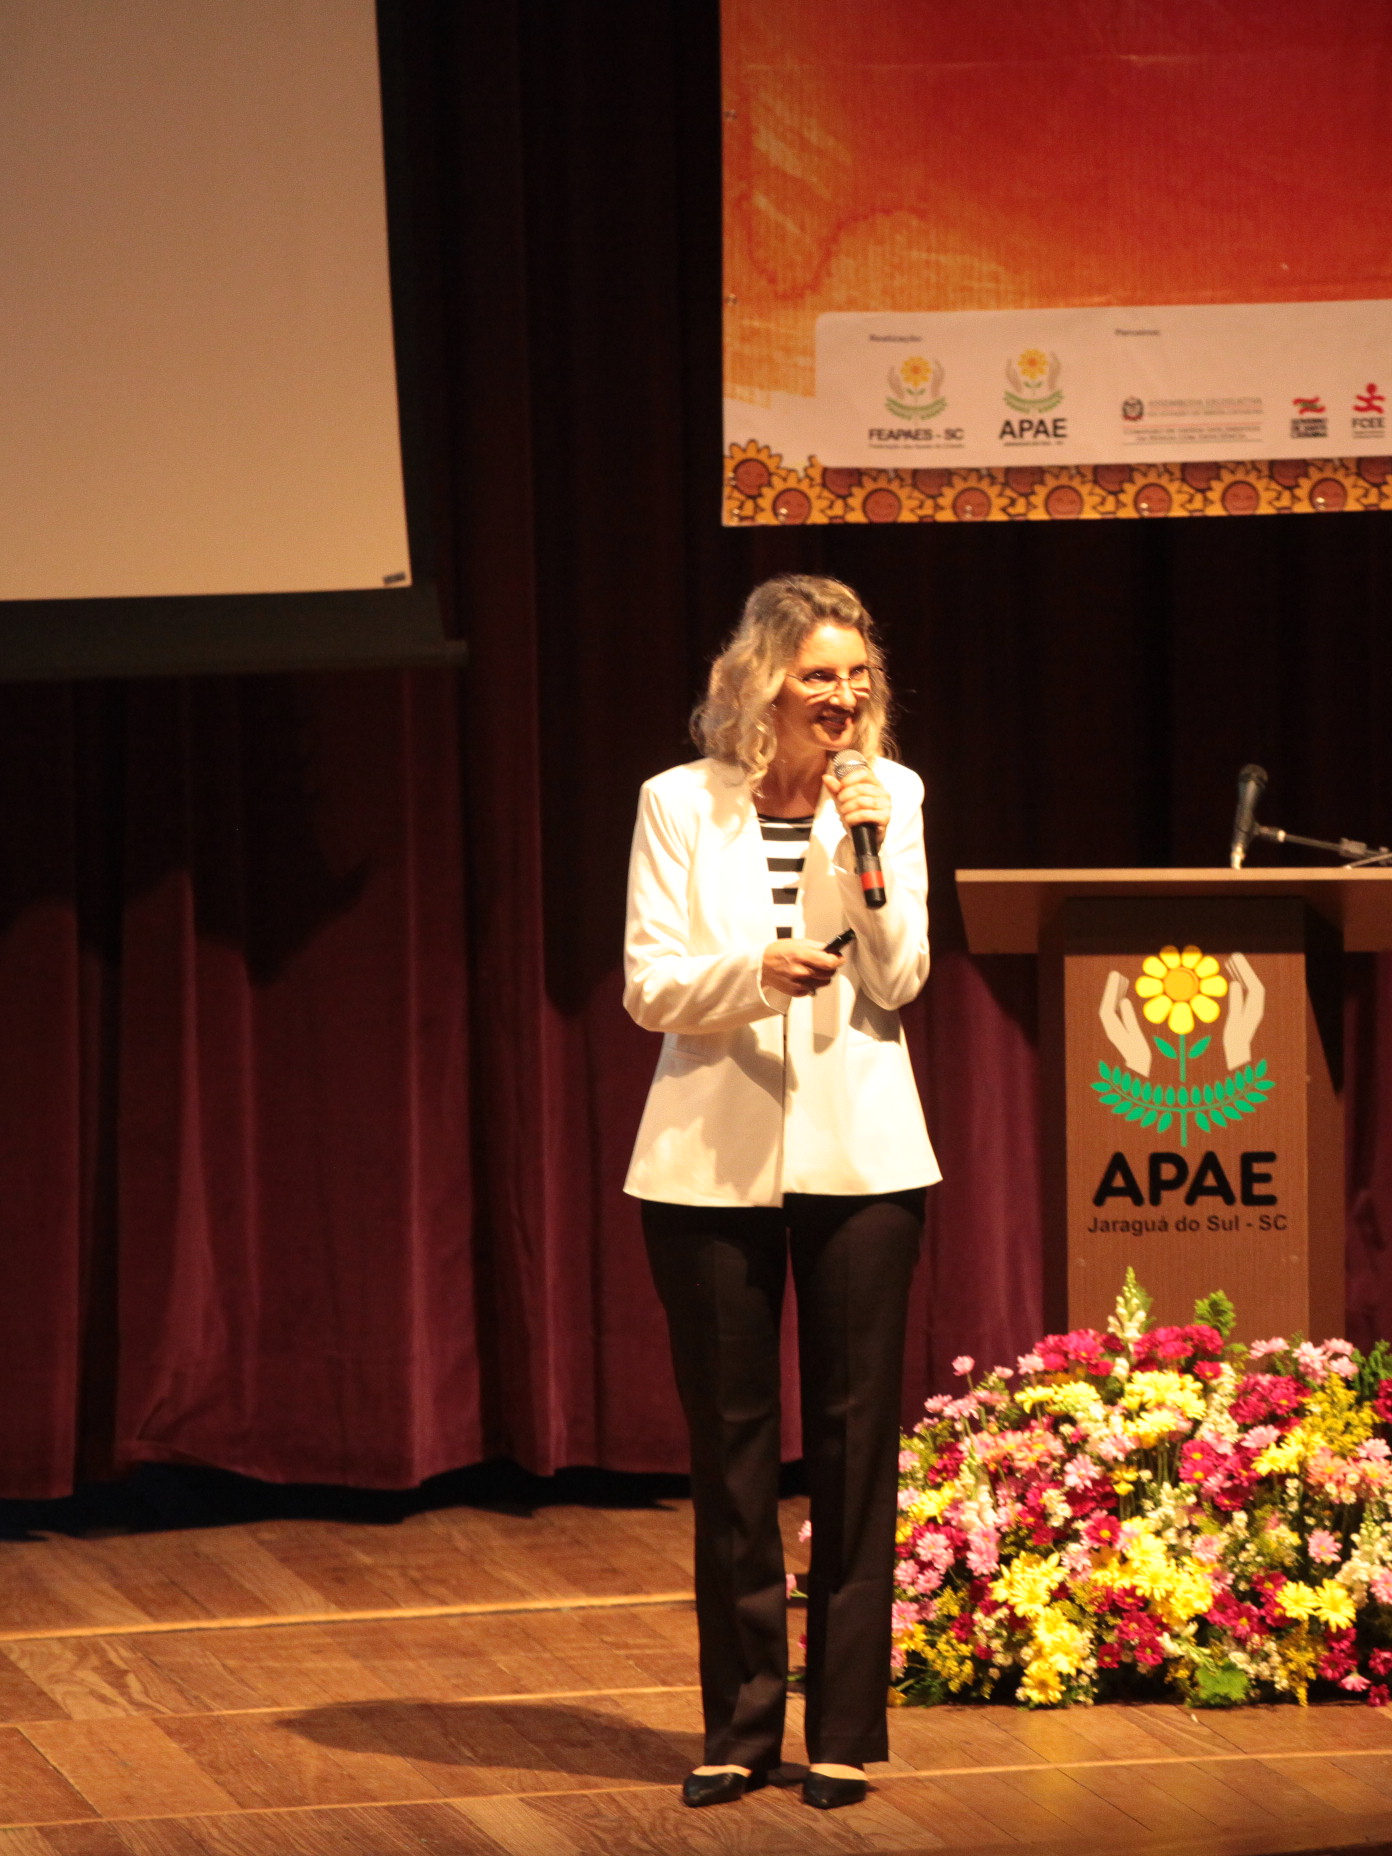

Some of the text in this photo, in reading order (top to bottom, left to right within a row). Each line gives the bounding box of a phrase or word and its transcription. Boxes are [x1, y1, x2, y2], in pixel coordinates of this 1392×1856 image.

[999, 418, 1067, 440] APAE
[1352, 417, 1385, 429] FCEE
[868, 428, 932, 442] FEAPAES
[944, 428, 964, 441] SC
[1092, 1151, 1278, 1207] APAE
[1087, 1216, 1168, 1236] Jaraguá
[1175, 1216, 1200, 1232] do
[1207, 1215, 1239, 1231] Sul
[1259, 1215, 1287, 1231] SC
